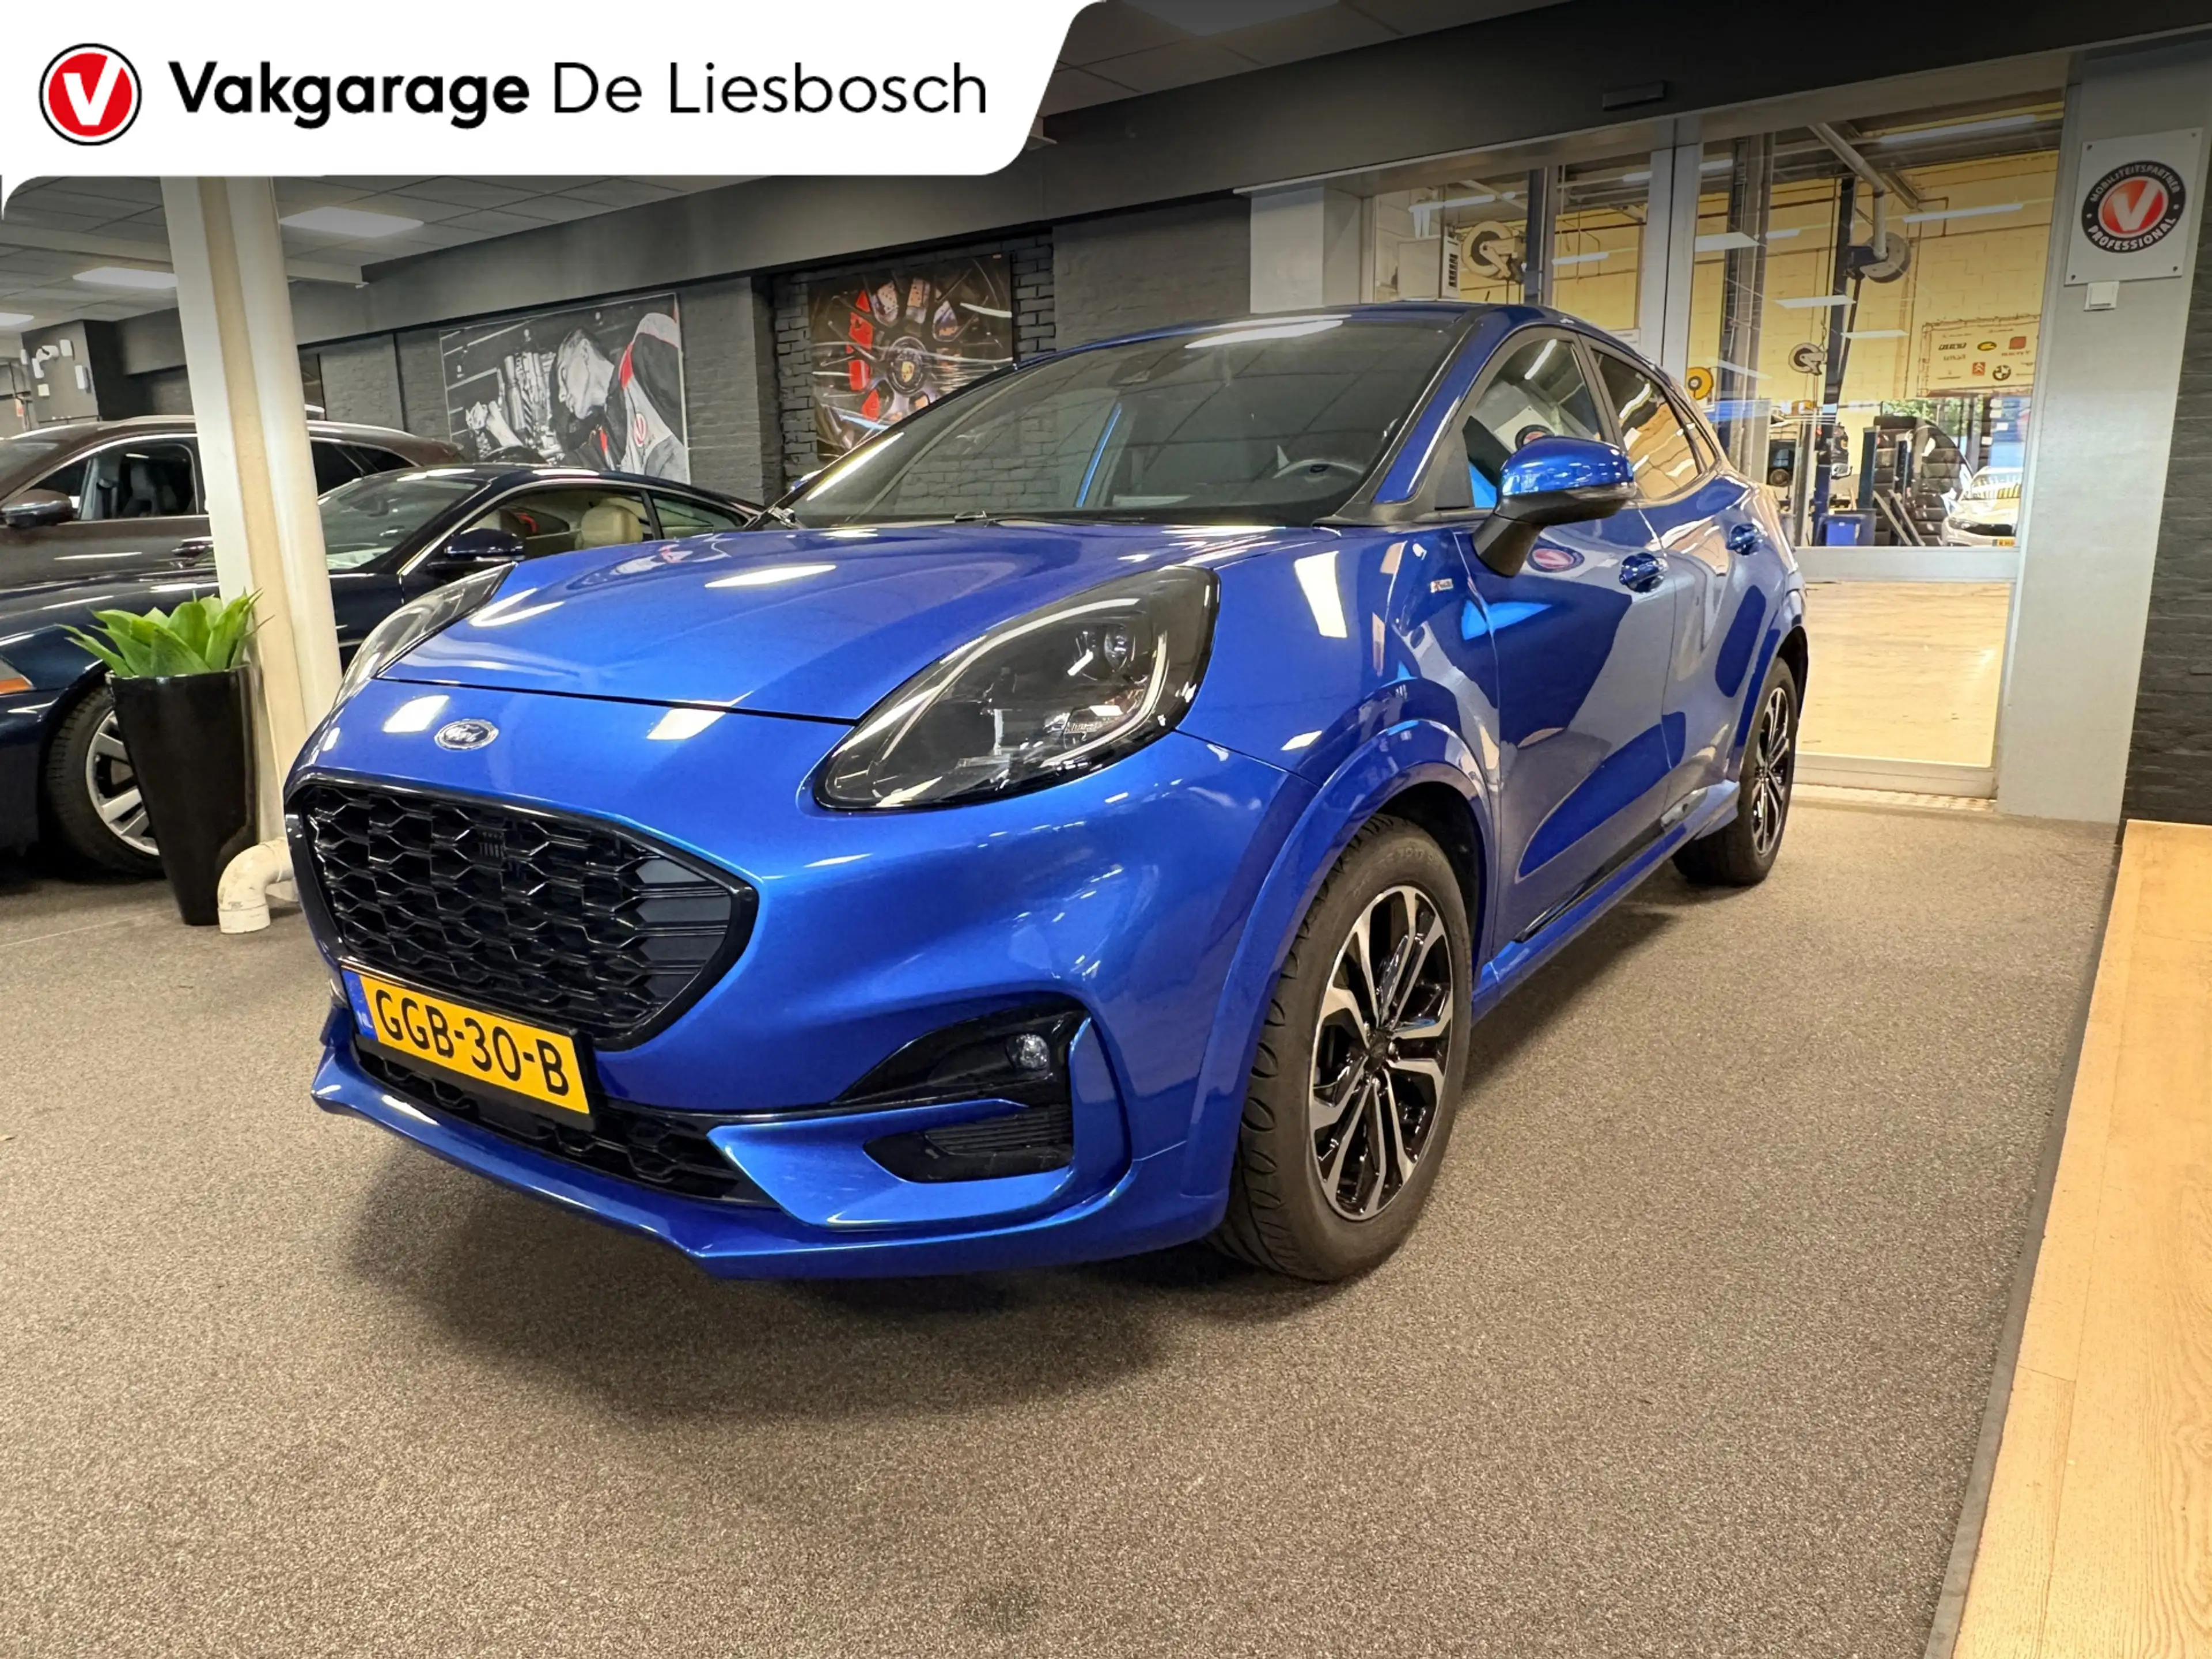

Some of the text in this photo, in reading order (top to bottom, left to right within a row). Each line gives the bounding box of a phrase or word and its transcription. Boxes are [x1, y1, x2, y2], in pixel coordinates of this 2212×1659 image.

[2089, 164, 2181, 203] MOBILITEITSPARTNER
[2087, 217, 2176, 251] PROFESSIONAL
[375, 989, 570, 1096] GGB-30-B
